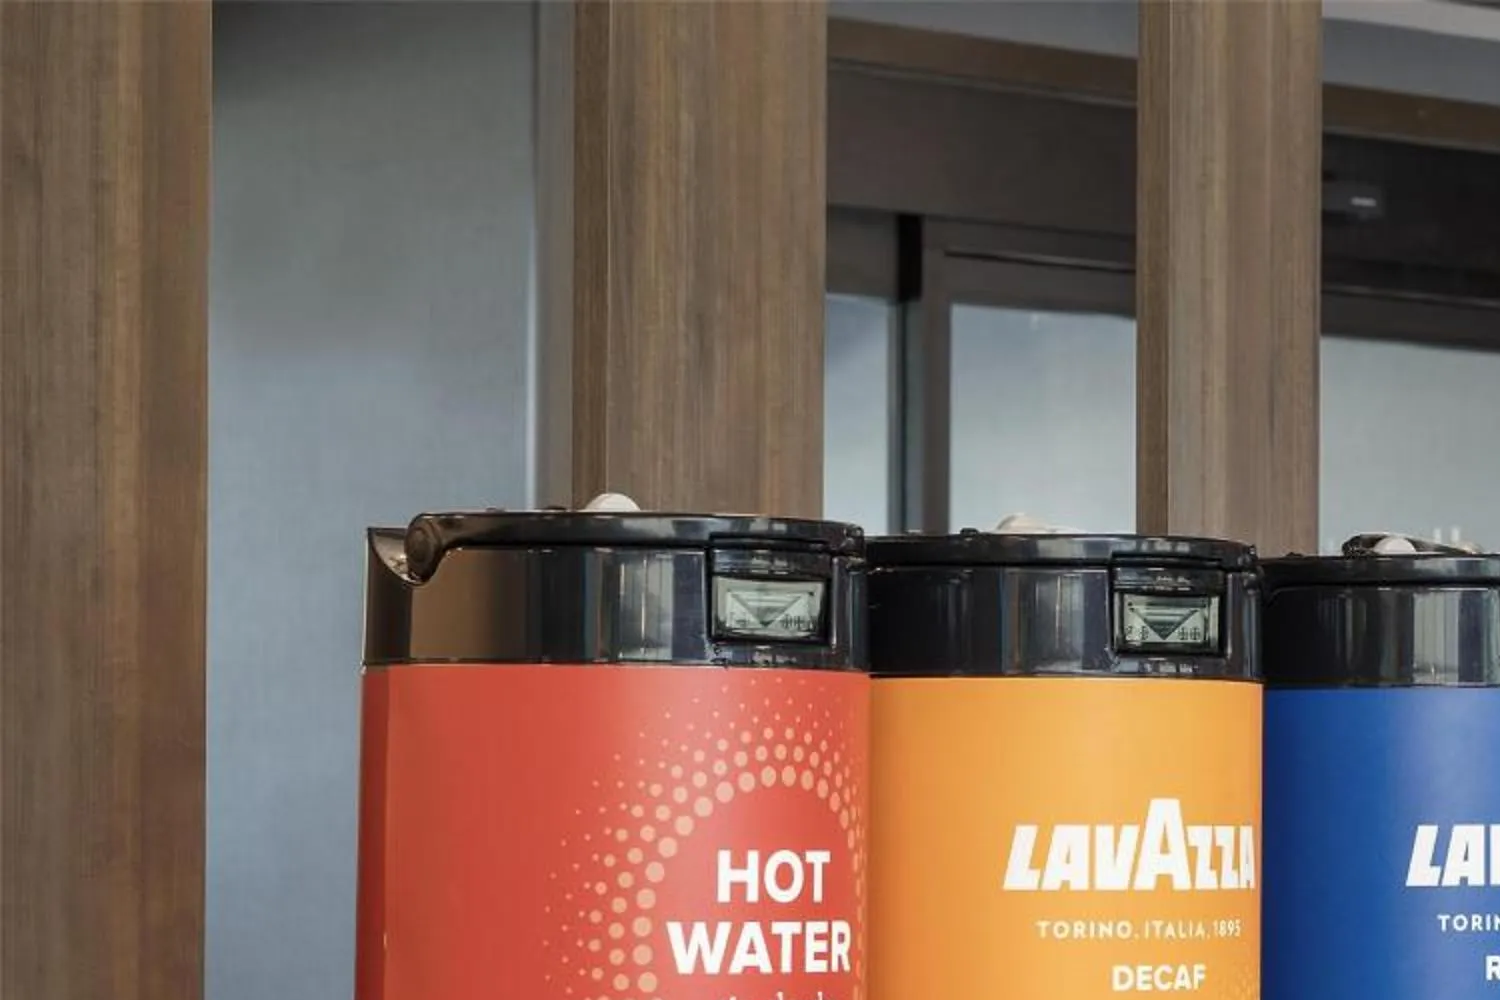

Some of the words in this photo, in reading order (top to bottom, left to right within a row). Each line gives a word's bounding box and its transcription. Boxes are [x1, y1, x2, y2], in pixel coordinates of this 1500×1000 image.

[1003, 797, 1255, 890] LAVAZZA
[716, 849, 831, 904] HOT
[665, 919, 852, 975] WATER
[1212, 918, 1242, 938] 1895
[1111, 963, 1207, 992] DECAF
